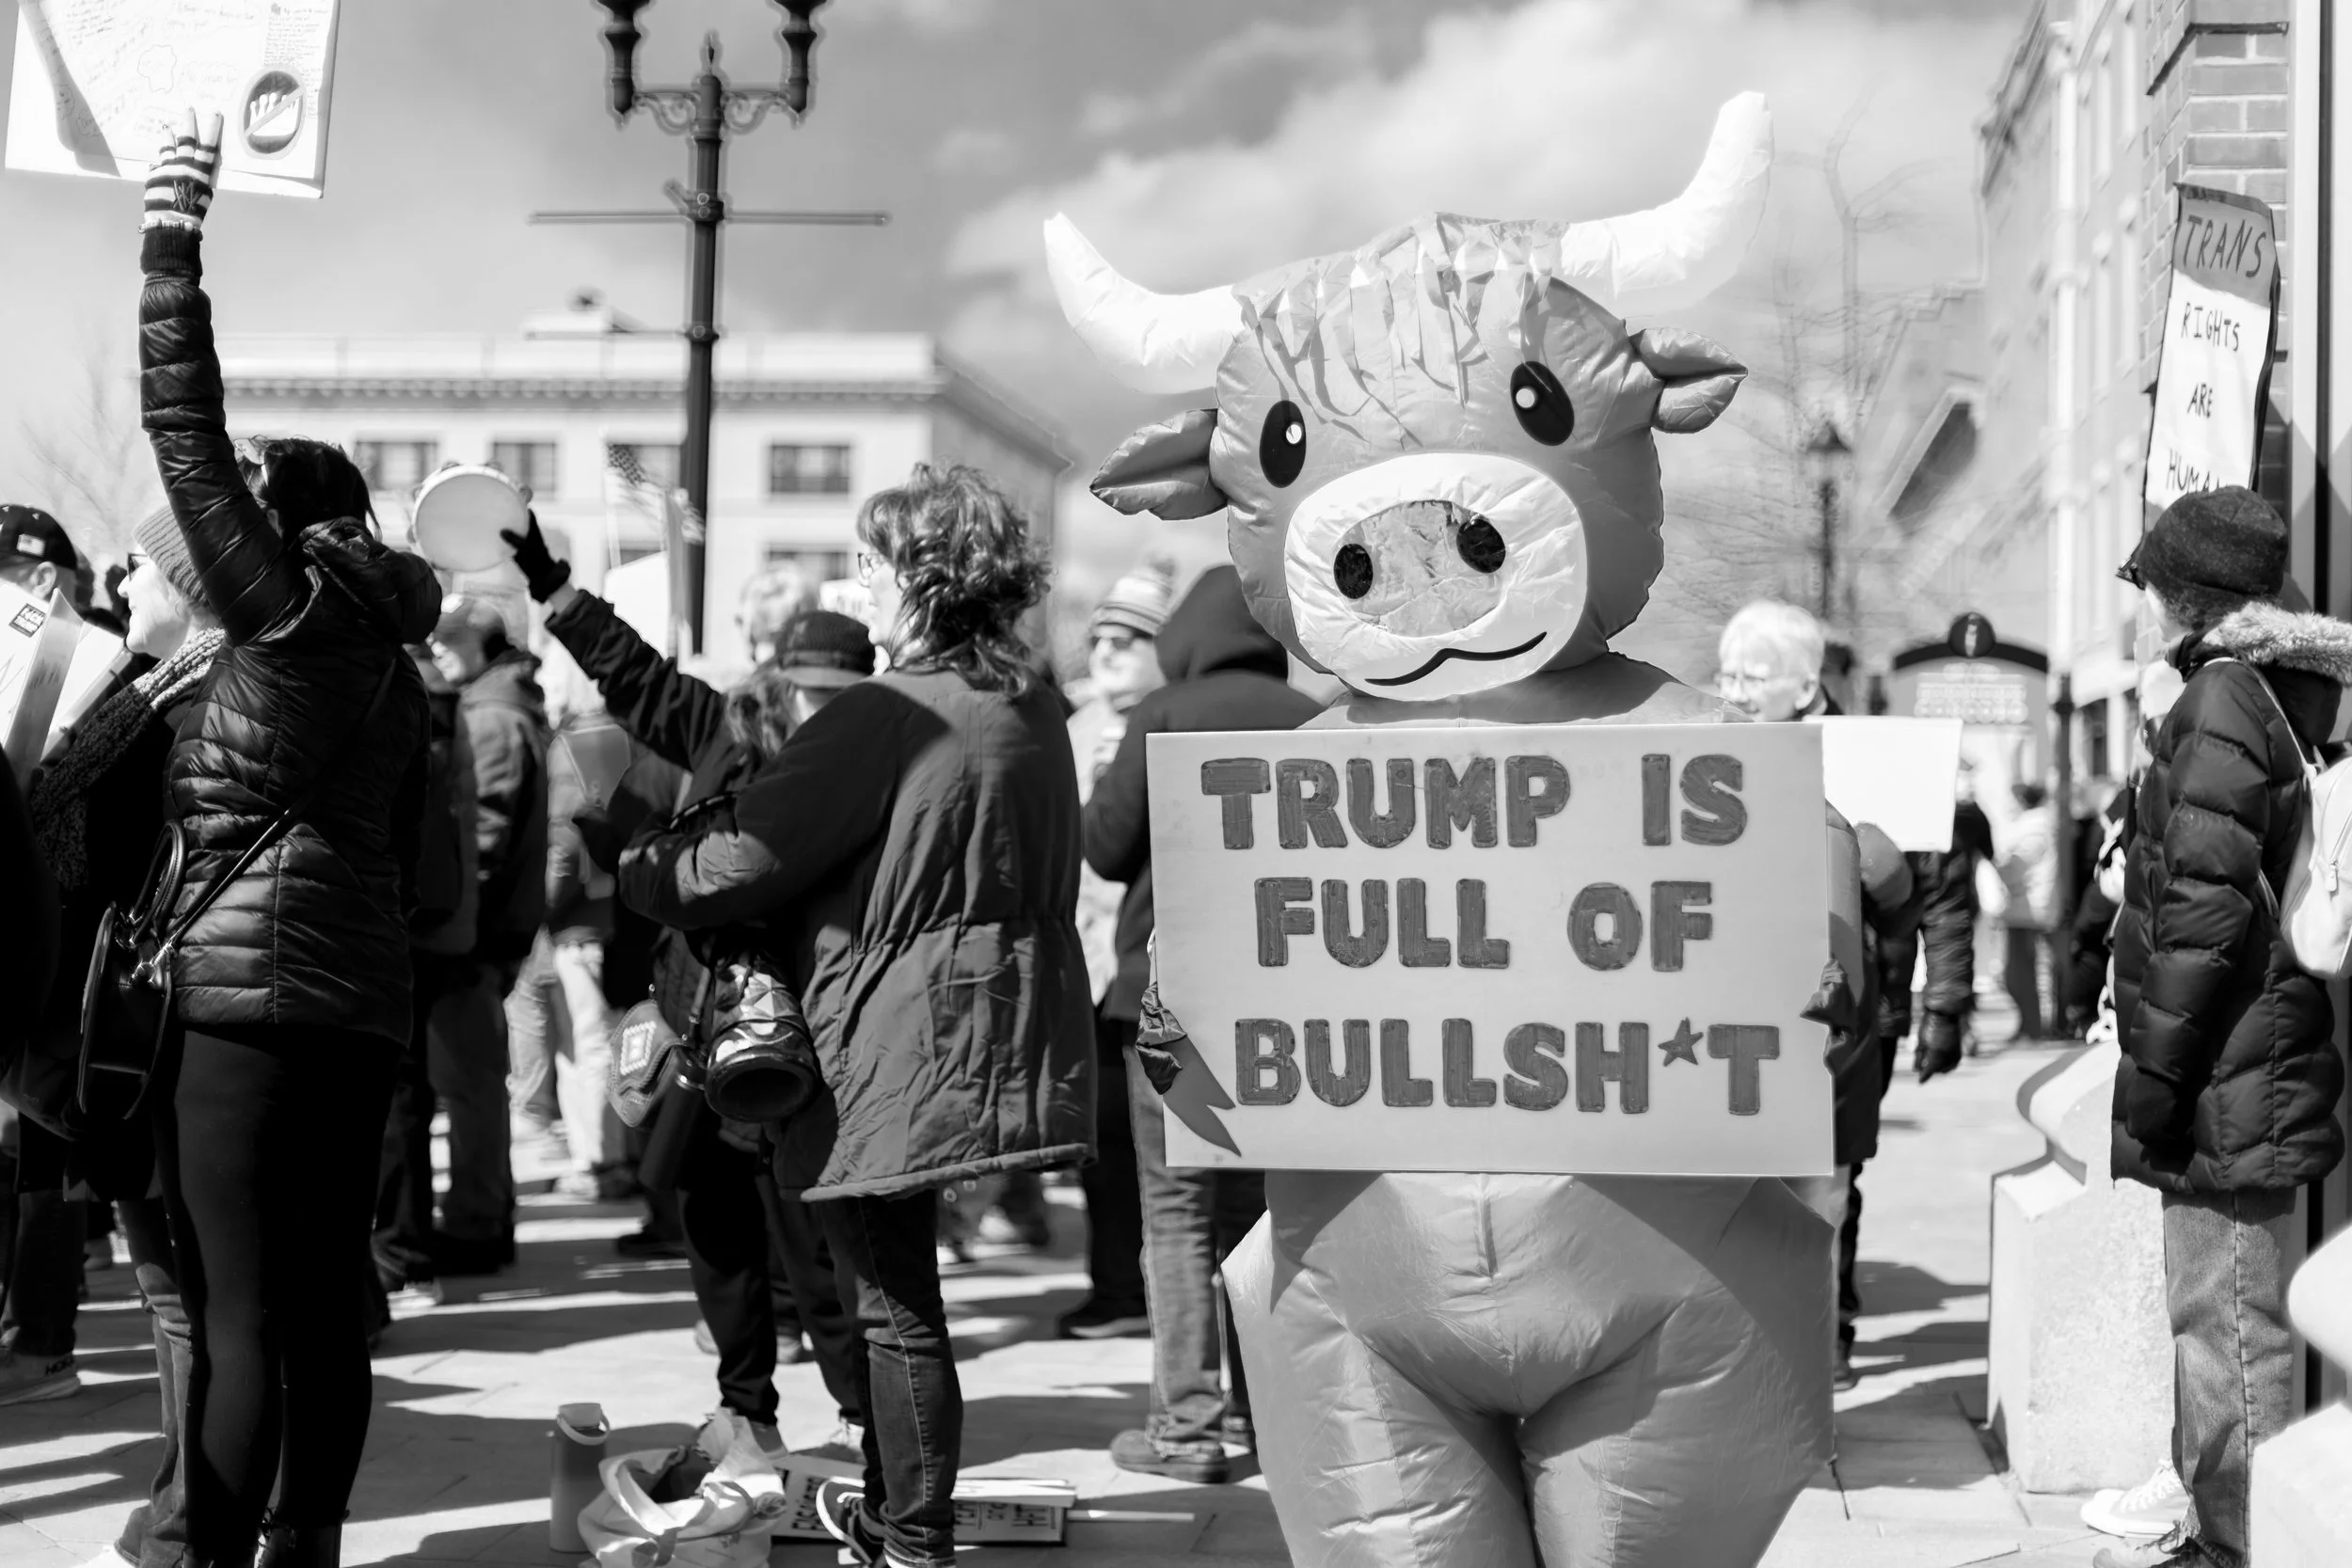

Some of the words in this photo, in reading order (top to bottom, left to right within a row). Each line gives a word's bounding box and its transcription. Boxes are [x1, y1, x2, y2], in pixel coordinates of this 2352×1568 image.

[2183, 215, 2266, 277] TRANS
[2181, 303, 2240, 352] RIGHTS
[2186, 383, 2213, 418] ARE
[2166, 449, 2228, 495] HUMA
[1200, 755, 1570, 848] TRUMP
[1642, 754, 1748, 846] IS
[1254, 878, 1510, 968] FULL
[1567, 880, 1712, 972] OF
